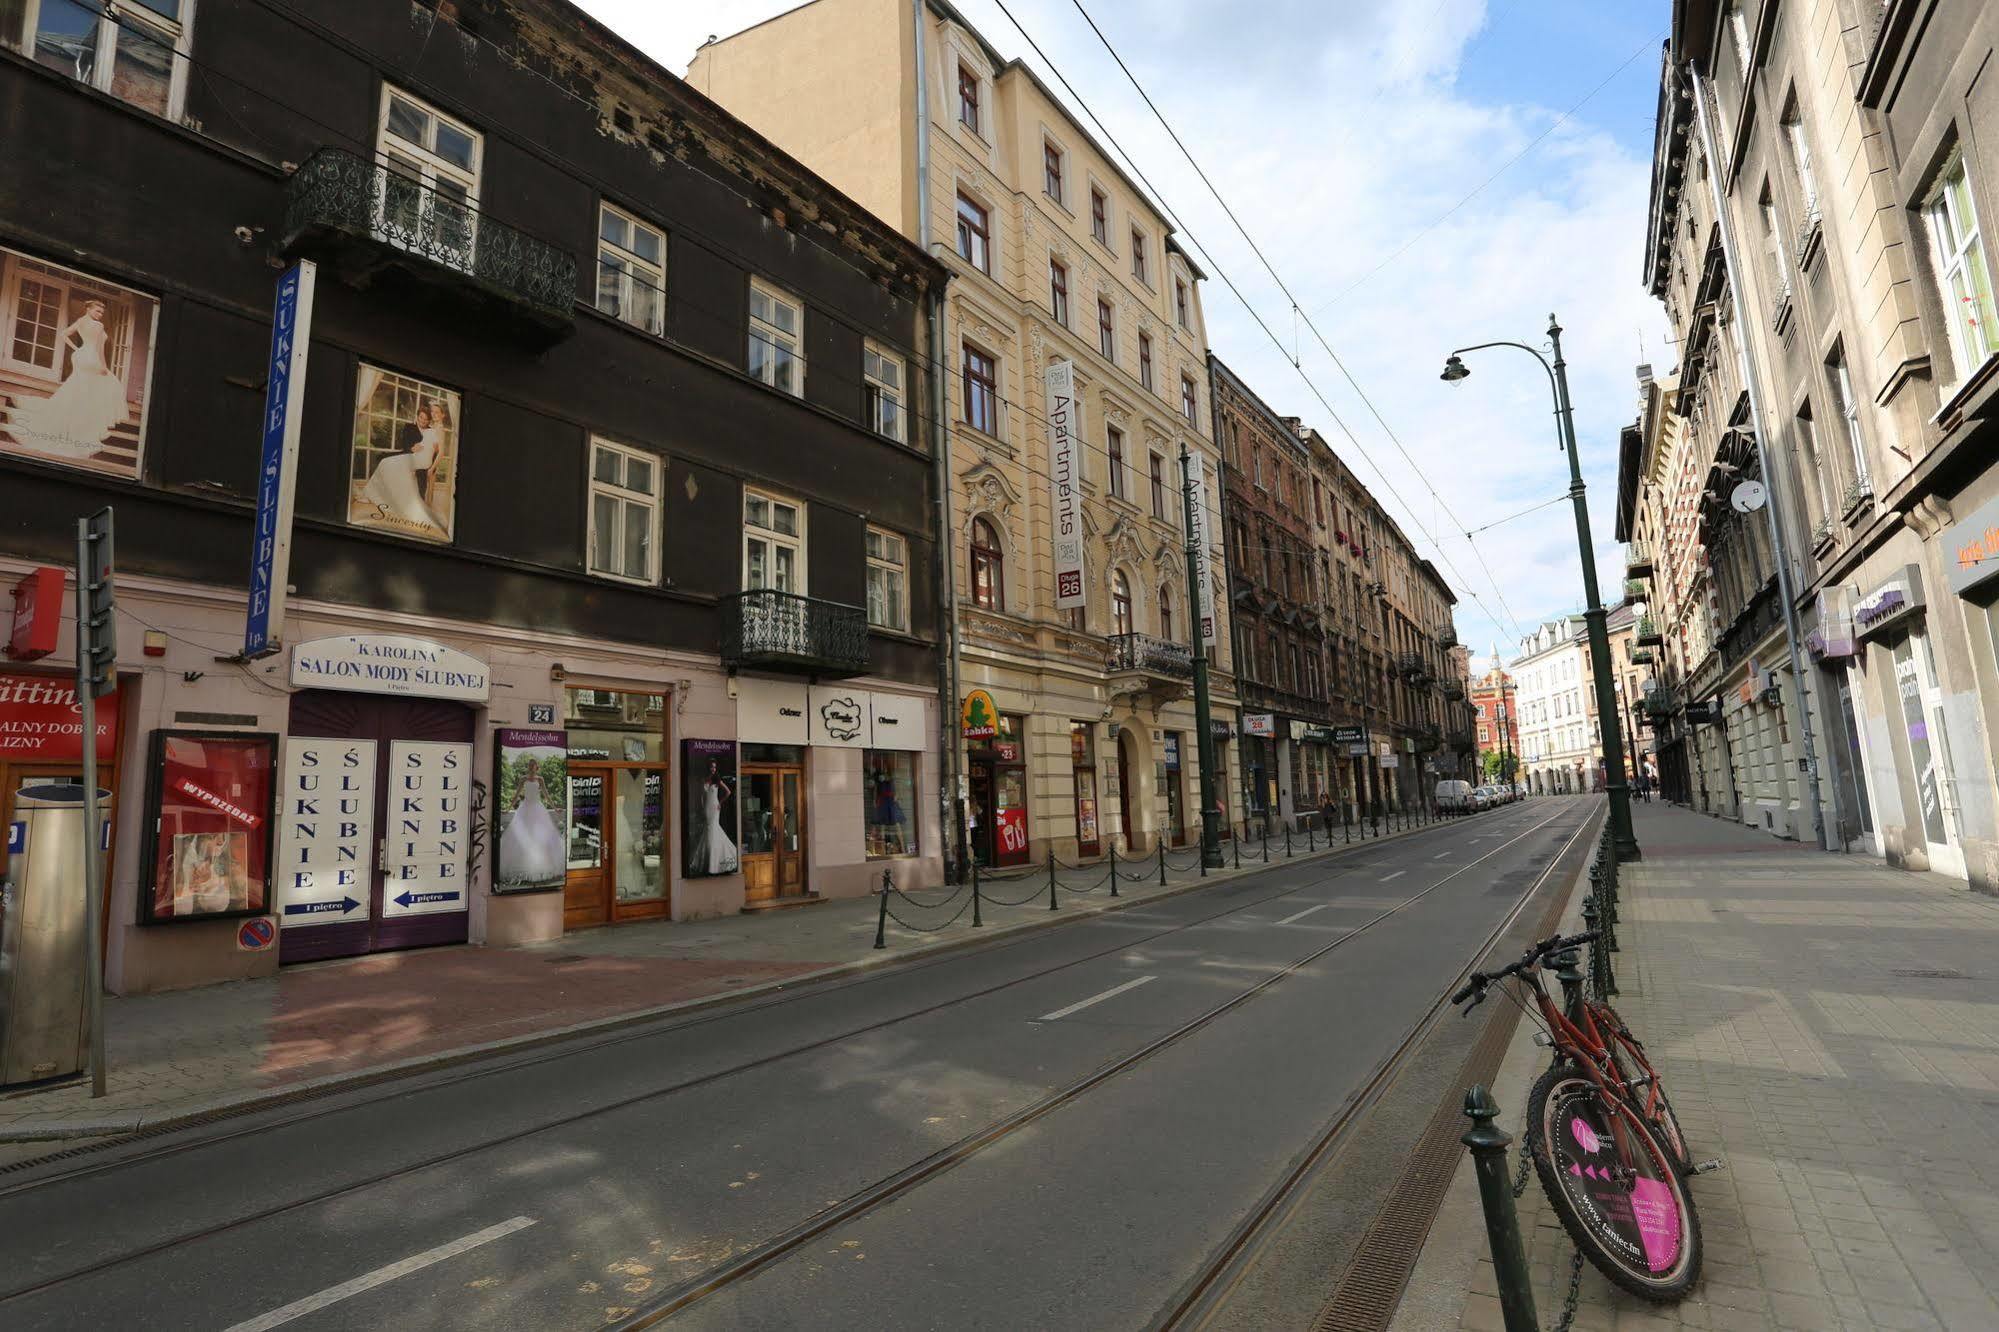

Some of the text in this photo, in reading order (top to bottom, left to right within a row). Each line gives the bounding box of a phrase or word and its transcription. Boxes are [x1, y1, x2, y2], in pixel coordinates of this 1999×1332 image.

[251, 280, 296, 618] SUKNIE ŚLUBNE
[1051, 394, 1074, 536] Apartments
[371, 503, 433, 533] Sincerity
[1061, 581, 1080, 596] 26
[300, 656, 484, 689] SALON MODY ŚLUBNEJ
[48, 722, 106, 735] DOBR
[533, 710, 550, 722] 24
[963, 726, 994, 736] żabka
[508, 731, 559, 742] Mendelssohn
[183, 781, 256, 825] WYPRZEDAŻ
[294, 750, 320, 888] SUKNIE
[337, 748, 360, 886] ŚLUBNE
[401, 752, 423, 881] SUKNIE
[439, 750, 458, 878] ŚLUBNE
[313, 902, 343, 913] piętro
[417, 894, 443, 903] piętro
[1583, 1193, 1641, 1257] www.taniec.fm
